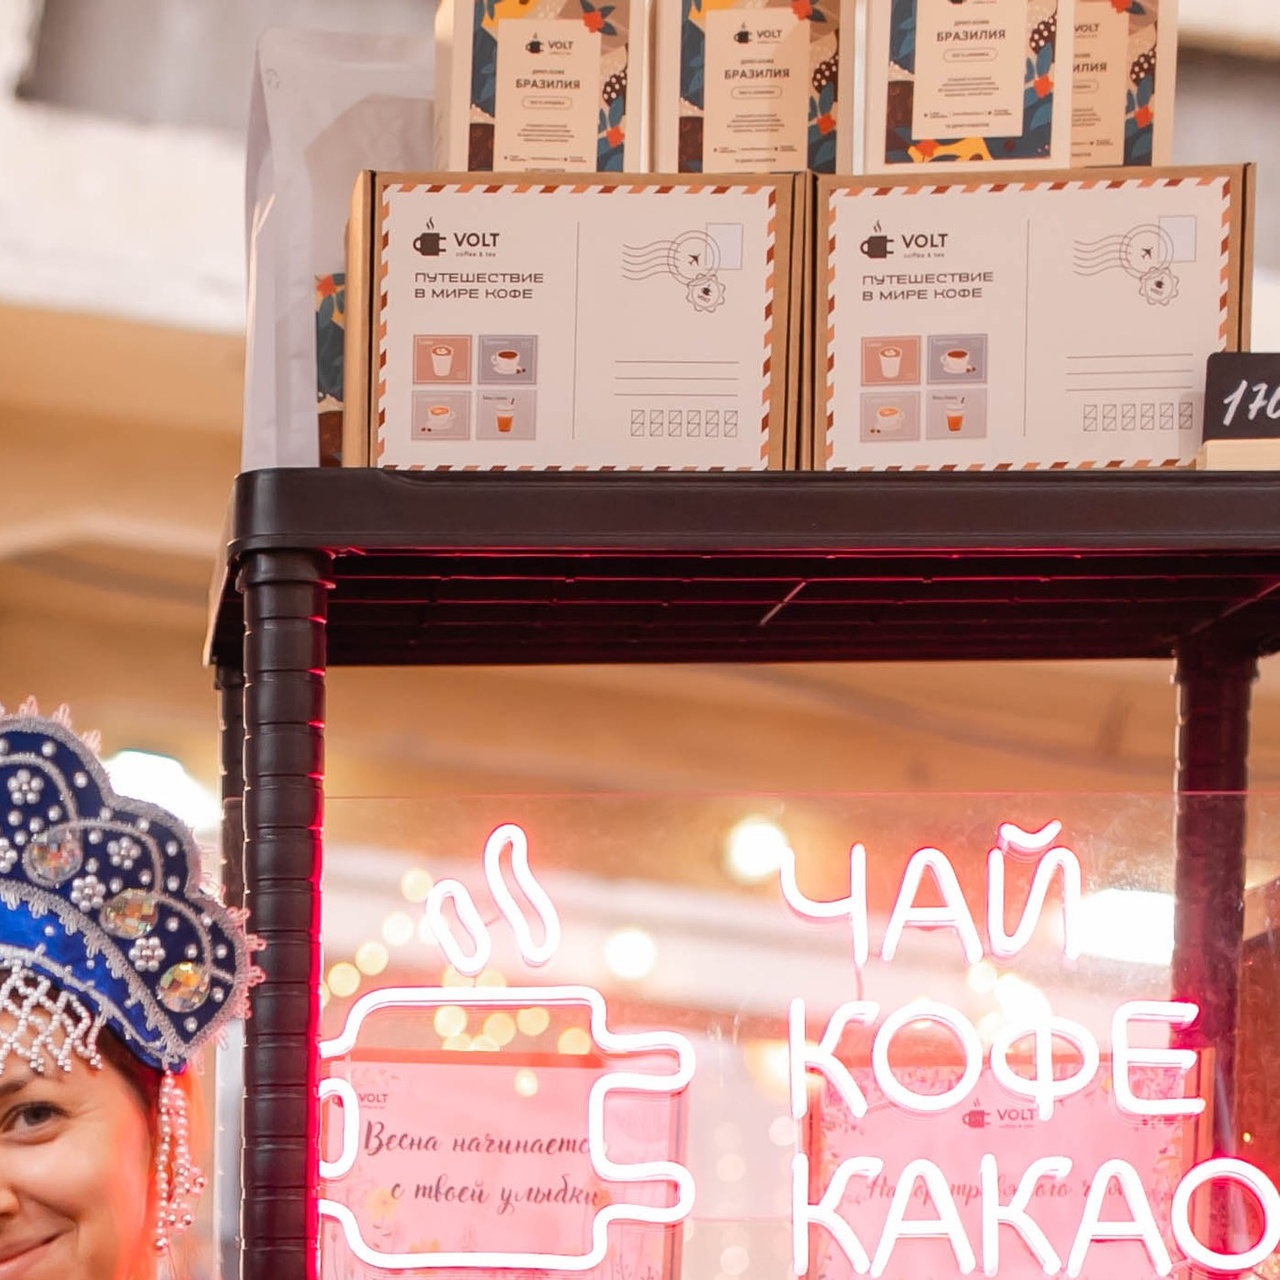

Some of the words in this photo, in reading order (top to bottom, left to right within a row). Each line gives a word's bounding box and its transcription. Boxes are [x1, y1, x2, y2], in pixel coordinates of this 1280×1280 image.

[756, 29, 782, 39] VOLT
[1074, 23, 1100, 33] VOLT
[936, 29, 1006, 42] БРАЗИЛИЯ
[547, 40, 574, 50] VOLT
[724, 68, 790, 80] БРАЗИЛИЯ
[515, 78, 581, 89] БРАЗИЛИЯ
[453, 232, 500, 247] VOLT
[901, 233, 949, 248] VOLT
[414, 272, 544, 284] ПУТЕШЕСТВИЕ
[862, 271, 994, 286] ПУТЕШЕСТВИЕ
[414, 288, 426, 299] В
[431, 288, 480, 299] МИРЕ
[485, 288, 533, 300] КОФЕ
[862, 290, 874, 301] В
[879, 288, 929, 301] МИРЕ
[933, 287, 983, 300] КОФЕ
[779, 819, 1083, 968] ЧАЙ
[788, 997, 1208, 1121] КОФЕ
[359, 1093, 389, 1104] VOLT
[997, 1108, 1037, 1121] VOLT
[364, 1119, 439, 1156] Весна
[452, 1133, 590, 1155] начинаетс
[391, 1181, 405, 1200] с
[414, 1173, 489, 1203] твоей
[499, 1172, 599, 1216] улыбки
[788, 1153, 1280, 1280] КАКАО
